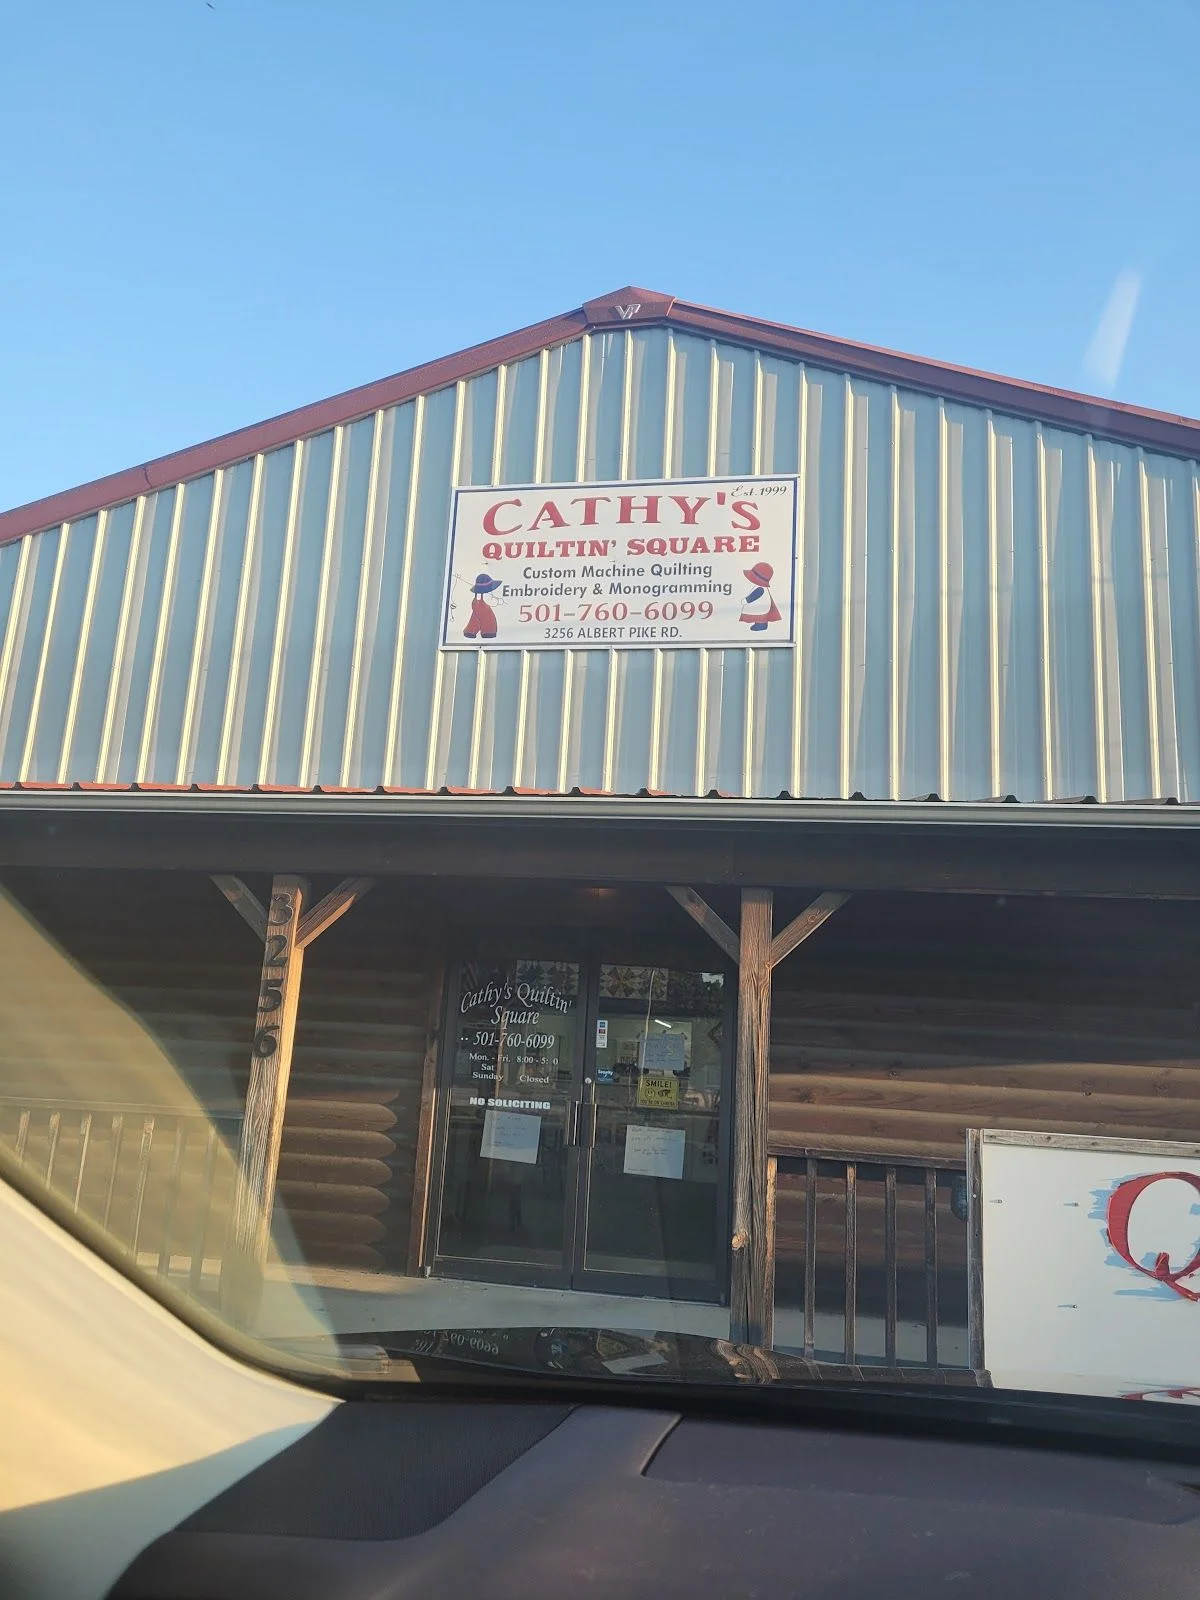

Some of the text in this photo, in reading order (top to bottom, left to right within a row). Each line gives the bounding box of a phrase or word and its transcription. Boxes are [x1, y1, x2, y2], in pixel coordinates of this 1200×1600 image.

[760, 485, 787, 497] 1999
[482, 491, 761, 536] CATHY'S
[482, 535, 760, 561] QUILTIN' SQUARE
[523, 562, 713, 579] Custom Machine Quilting
[502, 581, 733, 599] Embroidery & Monogramming
[518, 600, 714, 623] 501-760-6099
[544, 626, 683, 639] 3256 ALBERT PIKE RD.
[253, 893, 293, 1058] 3256
[460, 981, 572, 1013] Cathy's Quiltin'
[490, 1005, 540, 1030] Square
[473, 1031, 555, 1049] 501-760-6099
[469, 1053, 489, 1061] Mon.
[516, 1055, 534, 1064] 8:00
[472, 1072, 549, 1084] Sunday Closed
[469, 1097, 551, 1110] NO SOLICITING
